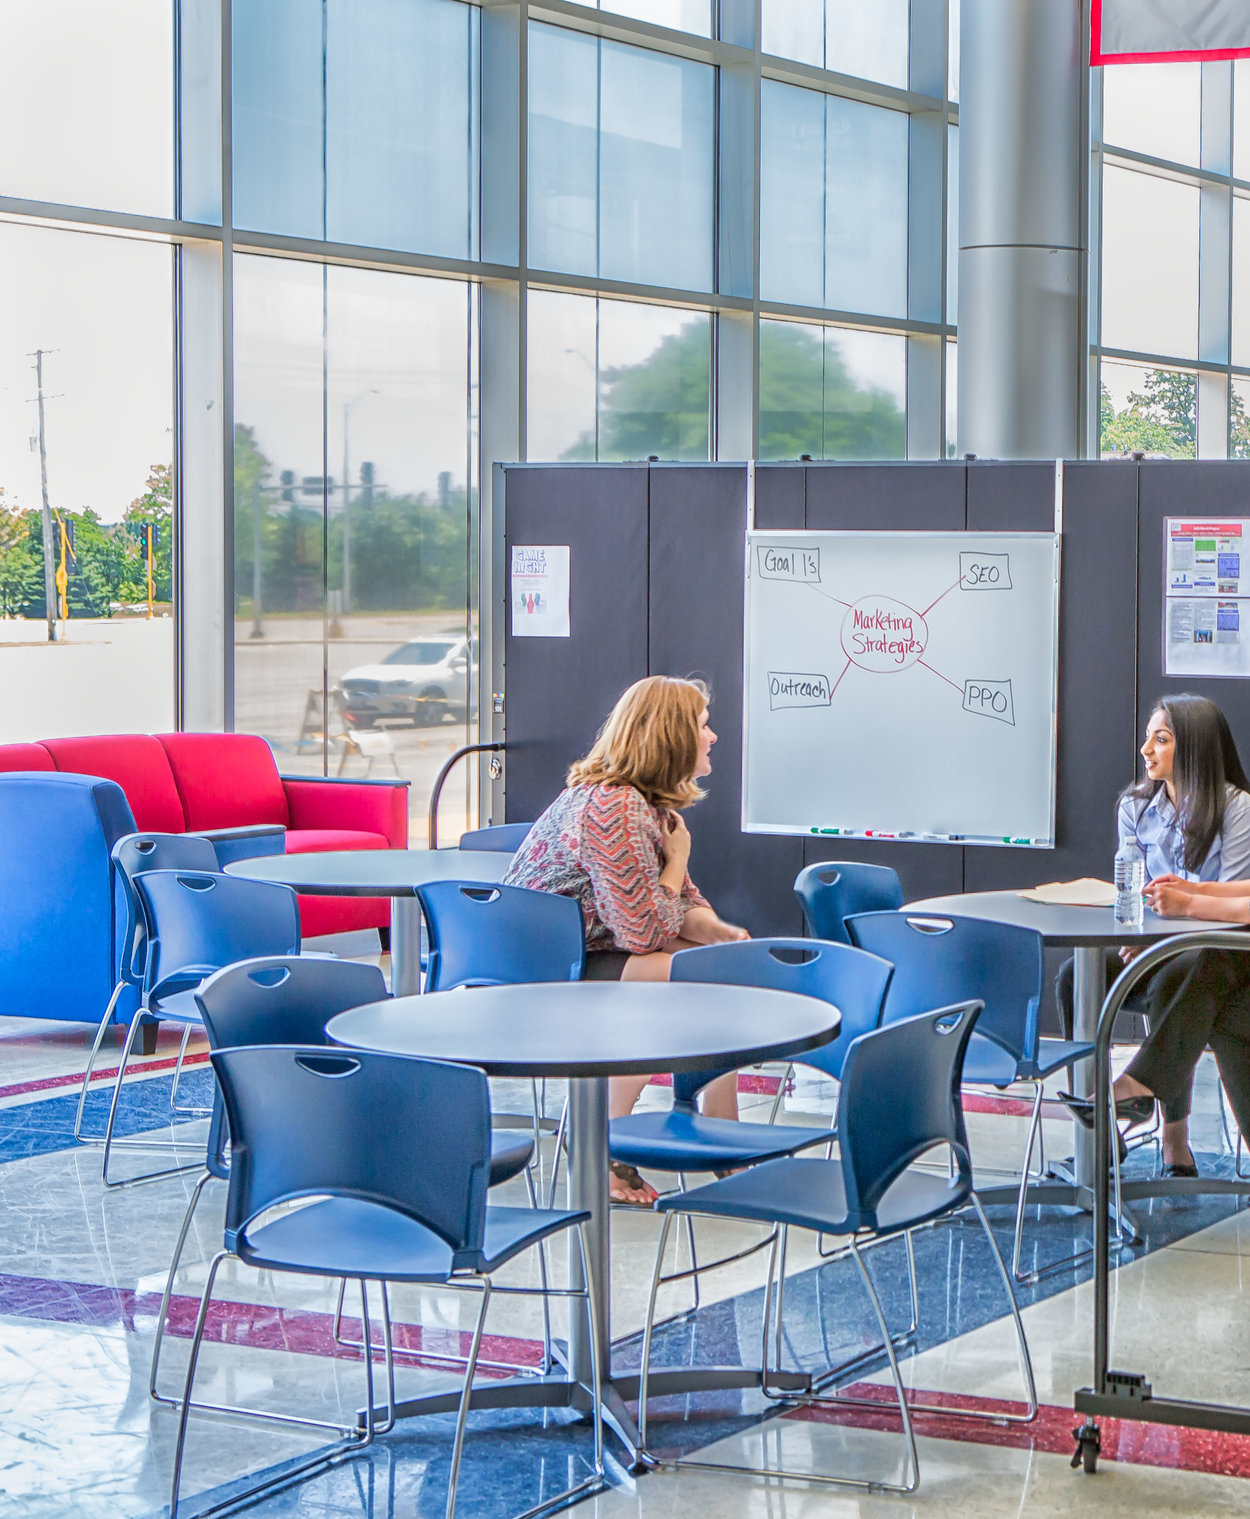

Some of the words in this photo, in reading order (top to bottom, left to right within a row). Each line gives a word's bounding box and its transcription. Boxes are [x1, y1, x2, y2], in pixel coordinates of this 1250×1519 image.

[514, 561, 546, 573] NIGHT
[516, 550, 545, 561] GAME
[765, 549, 795, 575] Goal
[968, 564, 1000, 585] SEO
[852, 633, 924, 664] Strategies
[770, 676, 827, 699] Outreach
[968, 685, 1008, 713] PPO
